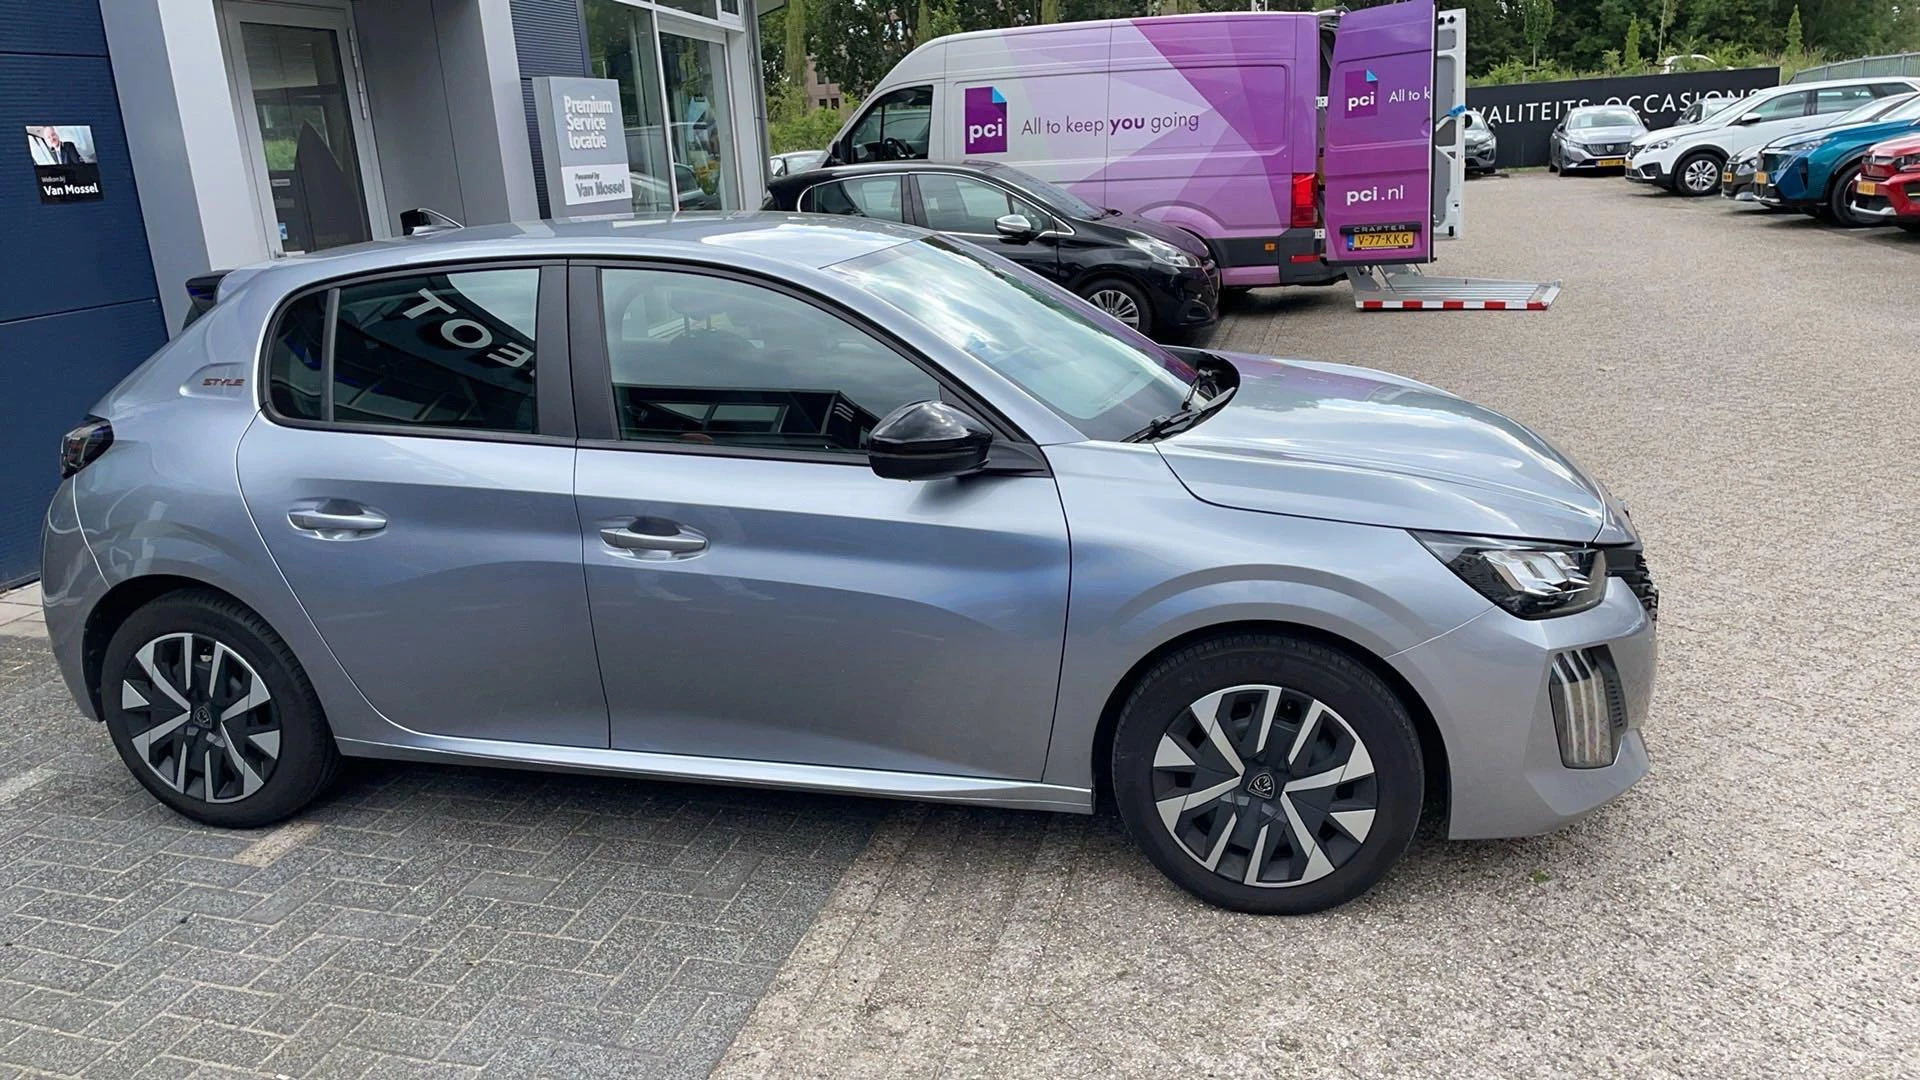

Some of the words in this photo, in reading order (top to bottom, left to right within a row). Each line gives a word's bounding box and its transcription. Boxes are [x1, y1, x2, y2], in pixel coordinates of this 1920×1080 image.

[564, 96, 613, 113] Premium
[1348, 91, 1375, 112] pci
[1388, 88, 1405, 104] All
[1408, 90, 1421, 101] to
[566, 114, 606, 130] Service
[1021, 117, 1041, 135] All
[1046, 119, 1061, 133] to
[1066, 116, 1104, 137] keep
[1110, 116, 1146, 136] you
[1150, 111, 1200, 134] going
[969, 118, 1003, 144] pci
[569, 131, 607, 149] locatie
[43, 186, 63, 195] Van
[65, 182, 99, 194] Mossel
[576, 183, 594, 197] Van
[595, 180, 625, 195] Mossel
[1346, 184, 1404, 206] pci.nl
[1358, 234, 1409, 245] V-77-KKG
[203, 378, 245, 386] STYLE
